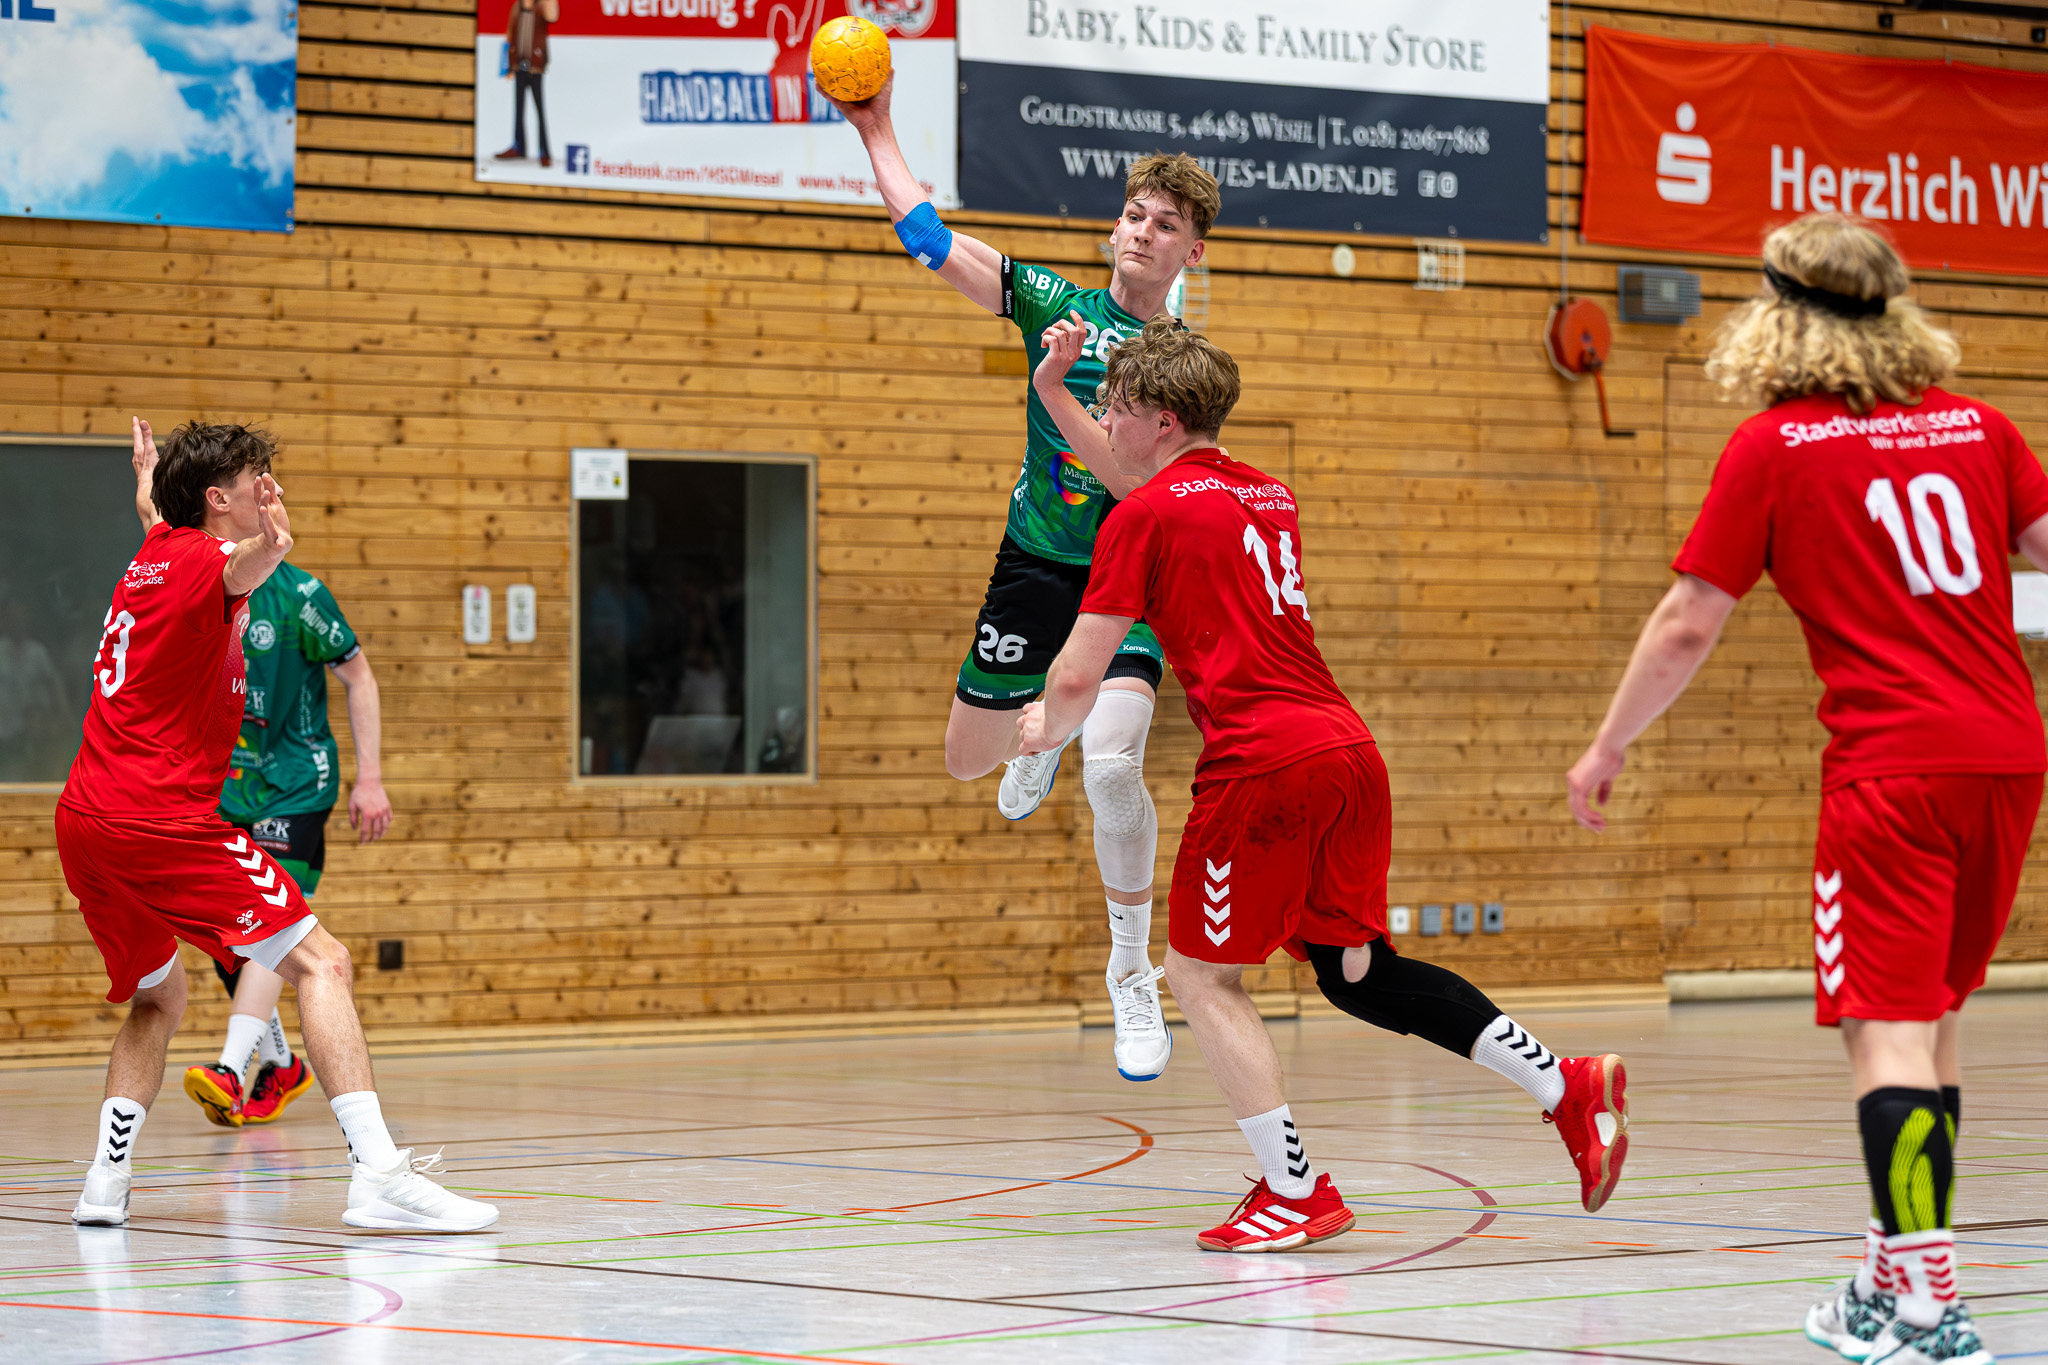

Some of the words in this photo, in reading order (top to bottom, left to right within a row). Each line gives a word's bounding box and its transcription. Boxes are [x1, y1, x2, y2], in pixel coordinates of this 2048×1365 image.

[1222, 20, 1247, 54] &
[641, 74, 772, 122] HANDBALL
[773, 76, 802, 121] IN
[1188, 109, 1250, 144] 46483
[1250, 112, 1316, 144] WESEL
[1770, 144, 1979, 226] Herzlich
[1081, 321, 1126, 363] 26
[1867, 435, 1894, 450] Wir
[1896, 434, 1927, 449] sind
[1253, 502, 1275, 511] sind
[1865, 472, 1984, 597] 10
[1242, 523, 1311, 621] 14
[977, 623, 1028, 664] 26
[1123, 644, 1150, 653] Kempa
[967, 687, 993, 699] Kempa
[1009, 687, 1034, 698] Kempa
